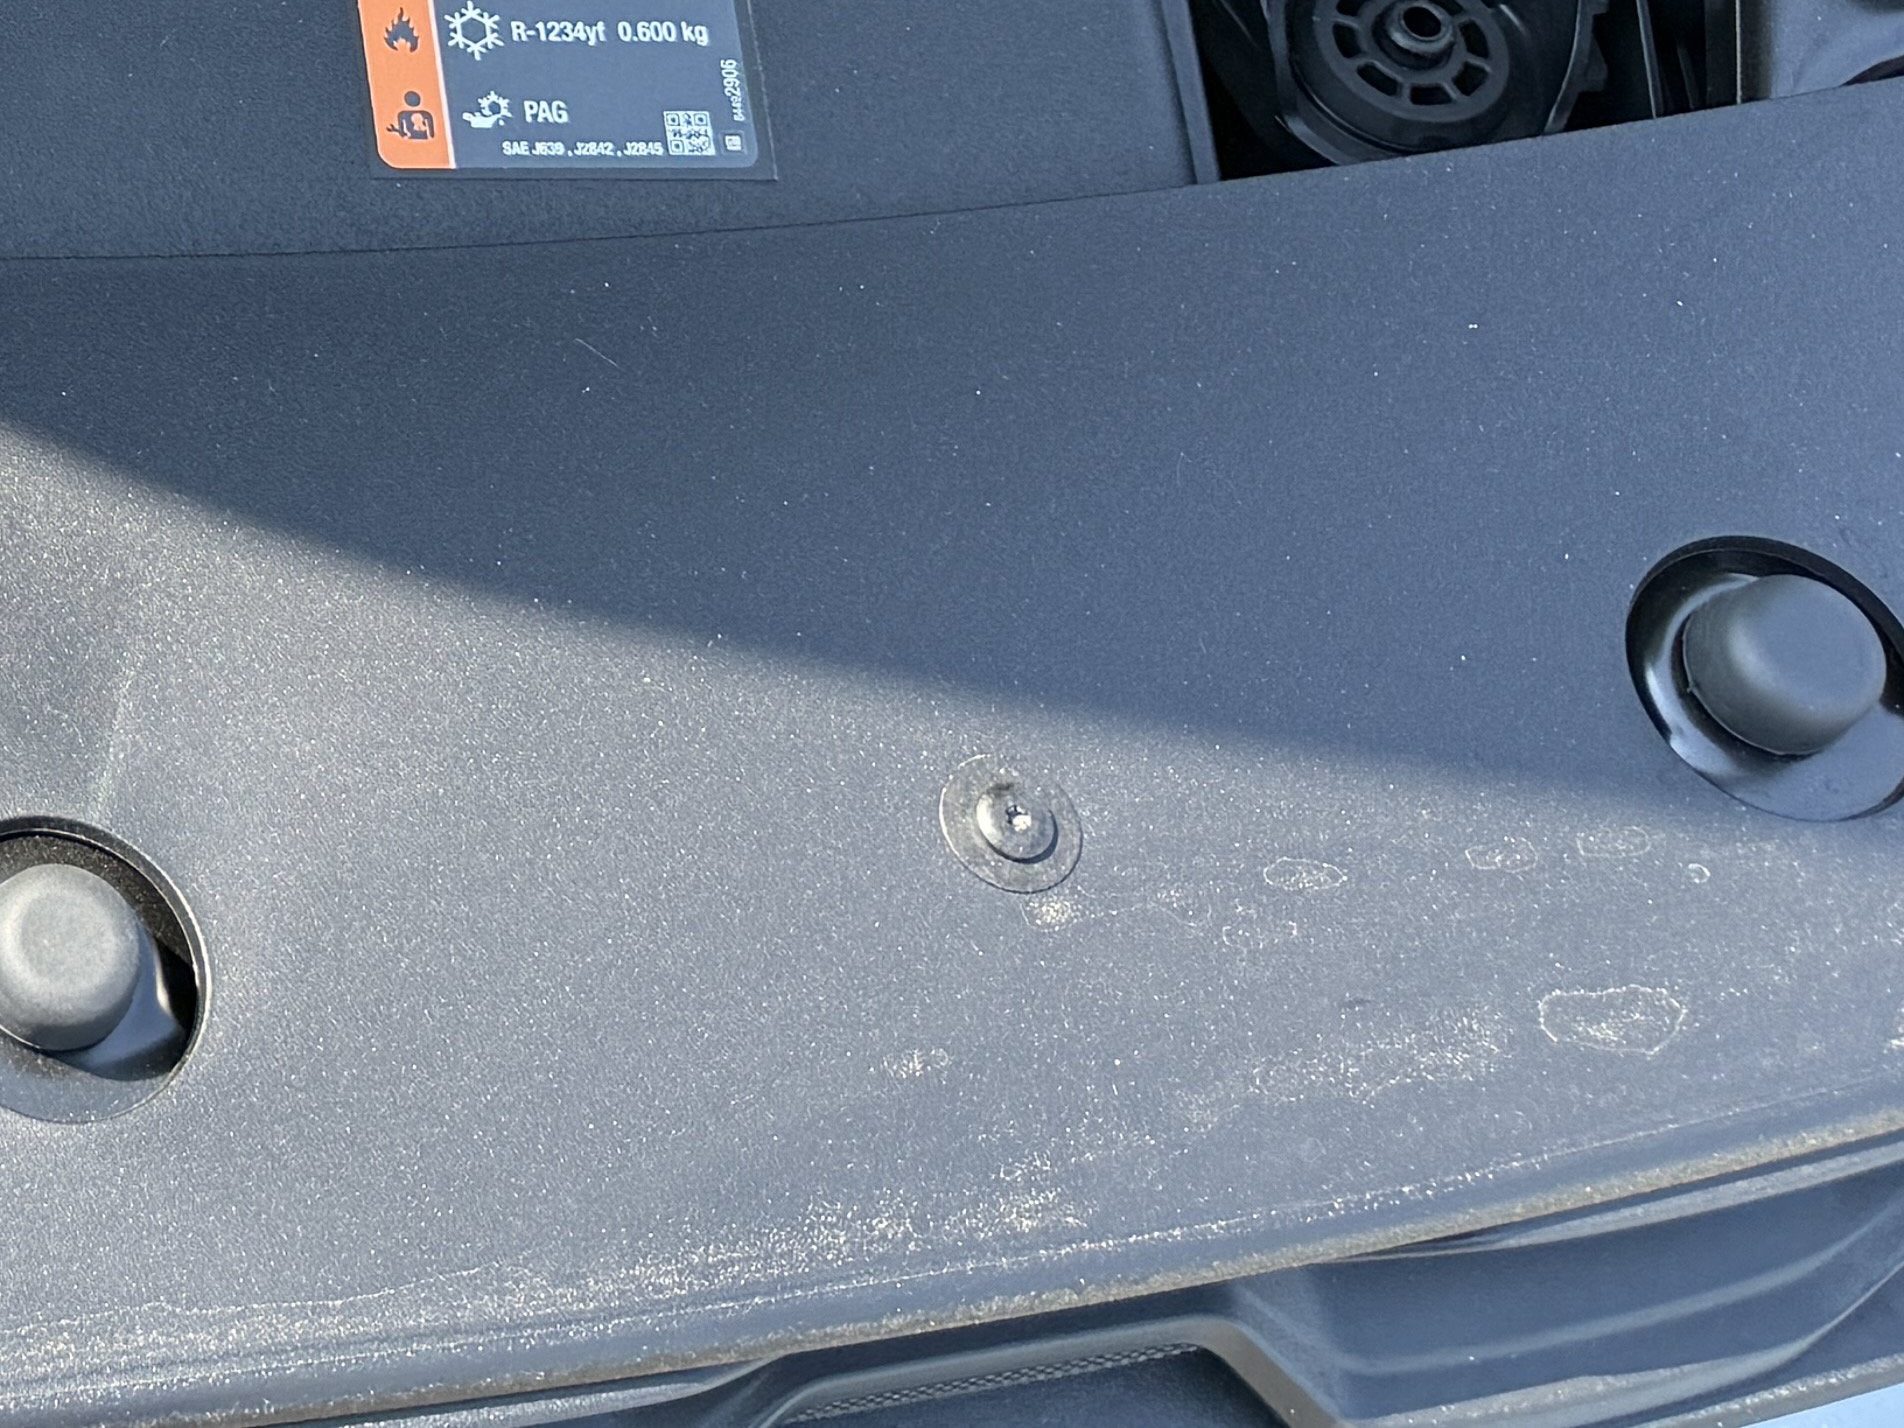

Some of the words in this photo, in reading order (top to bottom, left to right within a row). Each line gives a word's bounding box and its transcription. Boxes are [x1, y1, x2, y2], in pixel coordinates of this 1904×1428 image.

[510, 20, 607, 43] R-1234yf
[617, 21, 678, 43] 0.600
[682, 20, 709, 46] kg
[524, 100, 569, 123] PAG
[502, 141, 530, 156] SAE
[622, 140, 664, 156] J2845
